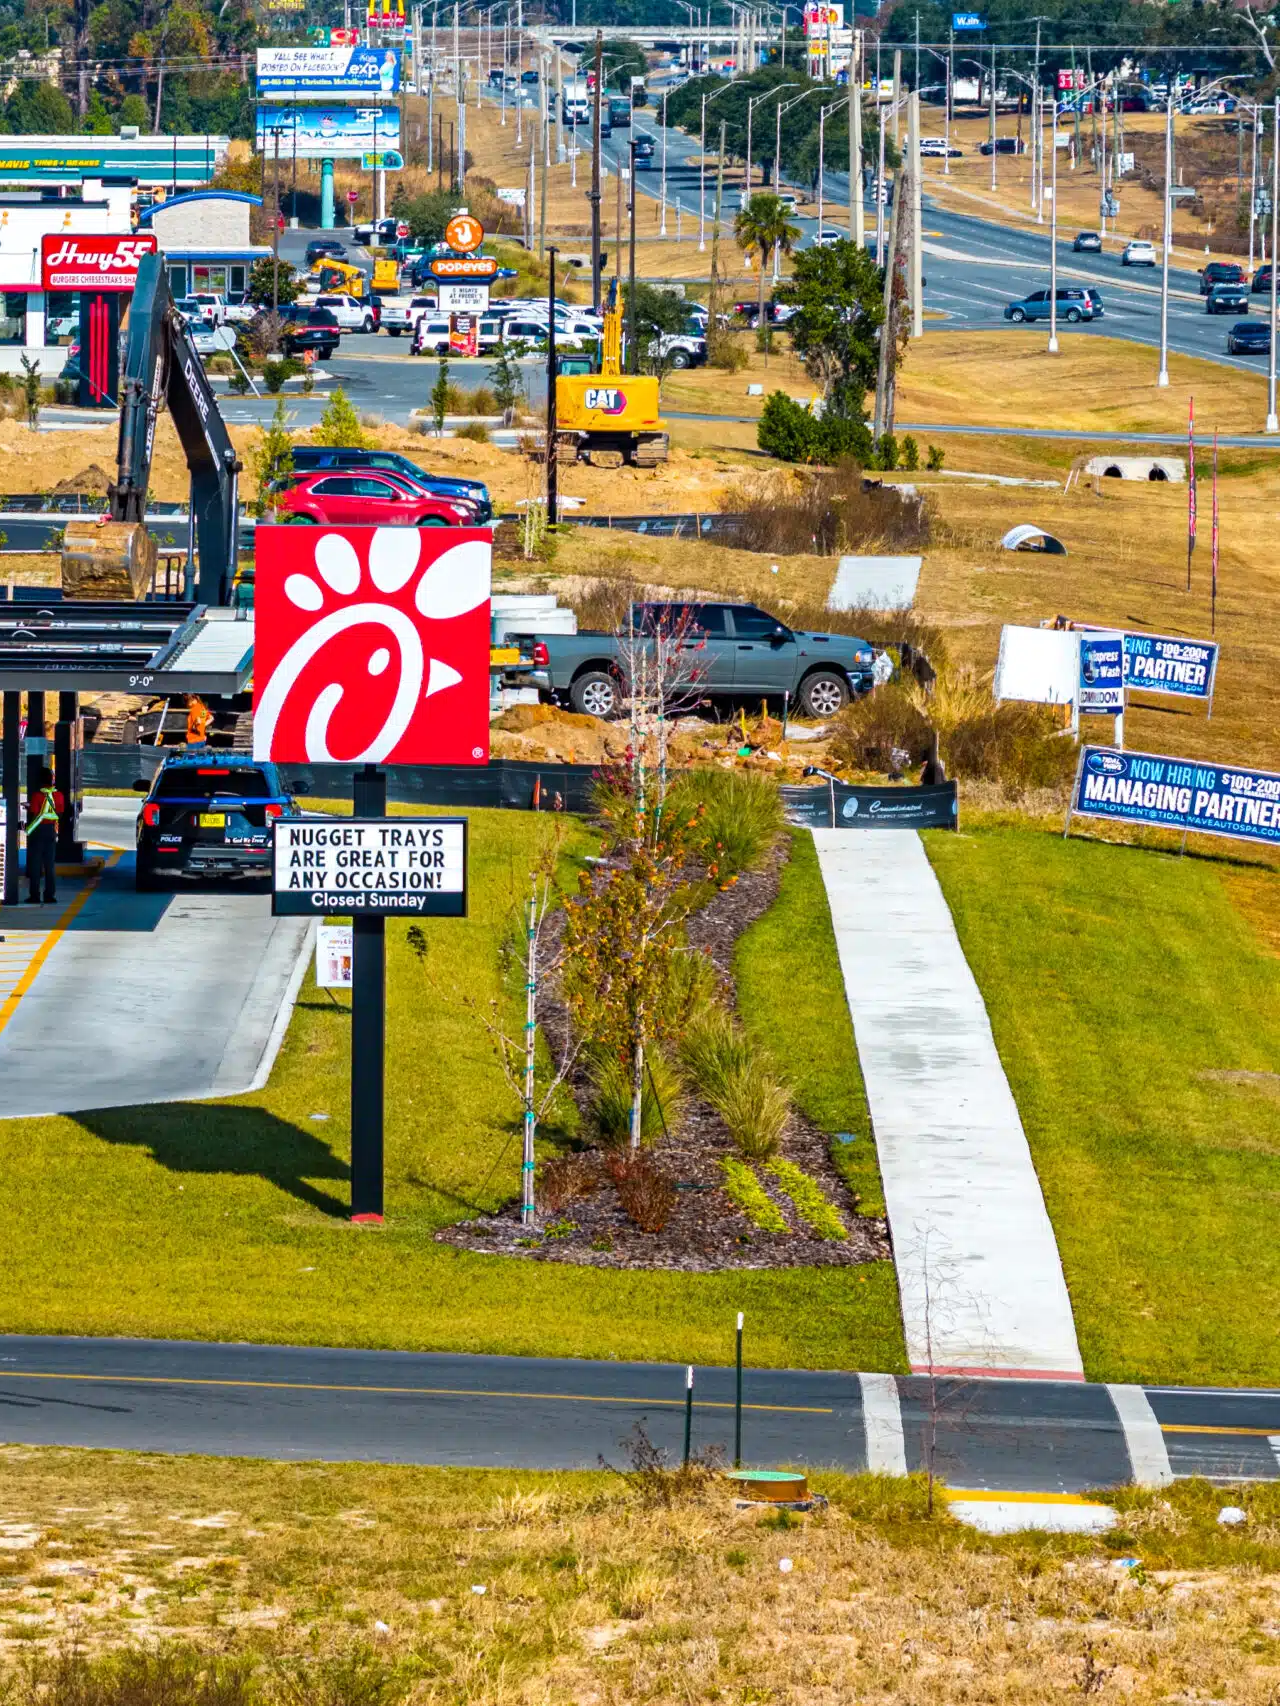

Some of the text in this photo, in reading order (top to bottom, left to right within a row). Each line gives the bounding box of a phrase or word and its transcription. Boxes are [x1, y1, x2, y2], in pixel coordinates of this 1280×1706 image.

[52, 275, 79, 284] BURGERS
[80, 275, 122, 284] CHEESESTEAKS
[184, 358, 210, 422] DEERE
[585, 389, 618, 409] CAT
[1155, 641, 1210, 660] $100-200K
[1133, 655, 1207, 686] PARTNER
[129, 675, 154, 686] 9'-0"
[1130, 759, 1165, 782] NOW
[1166, 764, 1216, 790] HIRING
[1084, 774, 1193, 813] MANAGING
[290, 828, 444, 846] NUGGET TRAYS
[289, 850, 445, 867] ARE GREAT FOR
[289, 871, 442, 889] ANY OCCASION!
[311, 892, 426, 910] Closed Sunday
